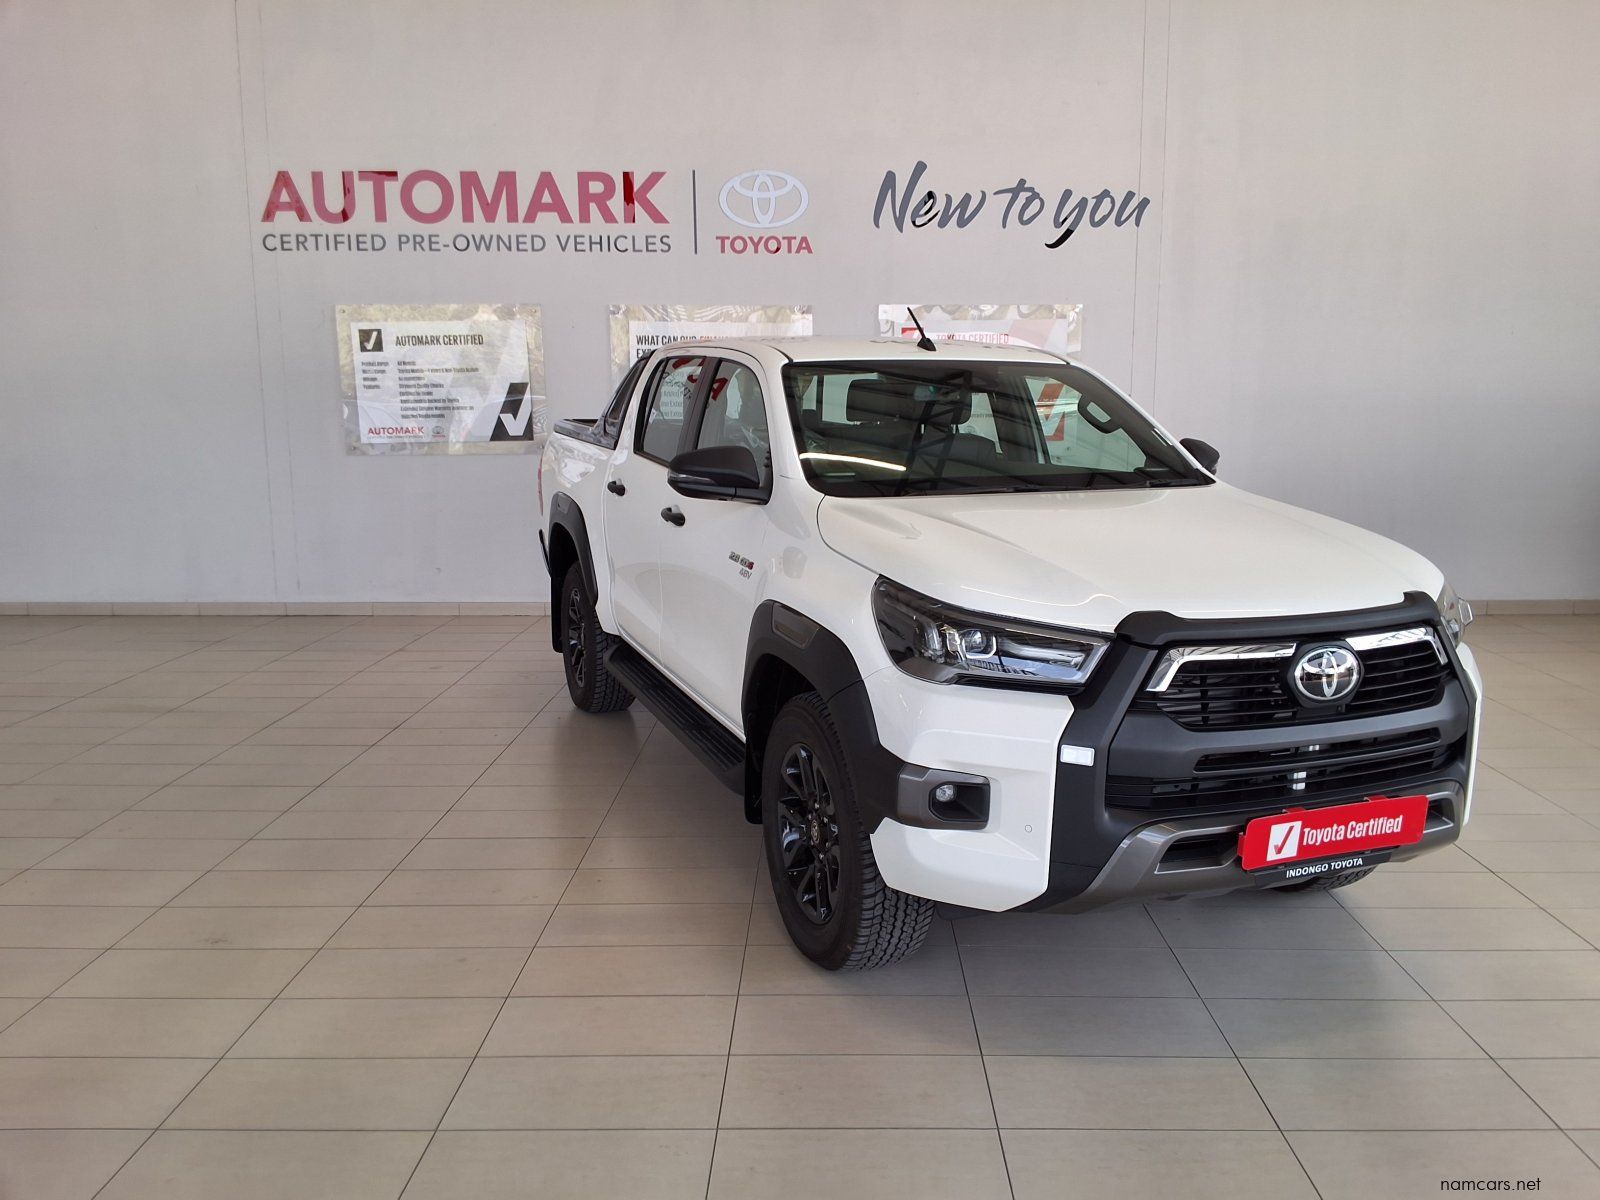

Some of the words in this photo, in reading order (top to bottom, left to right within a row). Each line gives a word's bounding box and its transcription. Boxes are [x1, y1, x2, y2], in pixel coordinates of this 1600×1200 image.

[261, 169, 670, 225] AUTOMARK
[873, 160, 987, 233] New
[993, 178, 1045, 229] to
[1044, 188, 1151, 249] you
[262, 234, 387, 252] CERTIFIED
[398, 234, 546, 252] PRE-OWNED
[556, 234, 672, 253] VEHICLES
[715, 236, 814, 254] TOYOTA
[395, 335, 441, 347] AUTOMARK
[442, 334, 484, 346] CERTIFIED
[636, 335, 660, 346] WHAT
[368, 426, 425, 435] AUTOMARK
[1302, 823, 1344, 846] Toyota
[1346, 814, 1404, 839] Certified
[1285, 863, 1329, 879] INDONGO
[1331, 857, 1364, 871] TOYOTA
